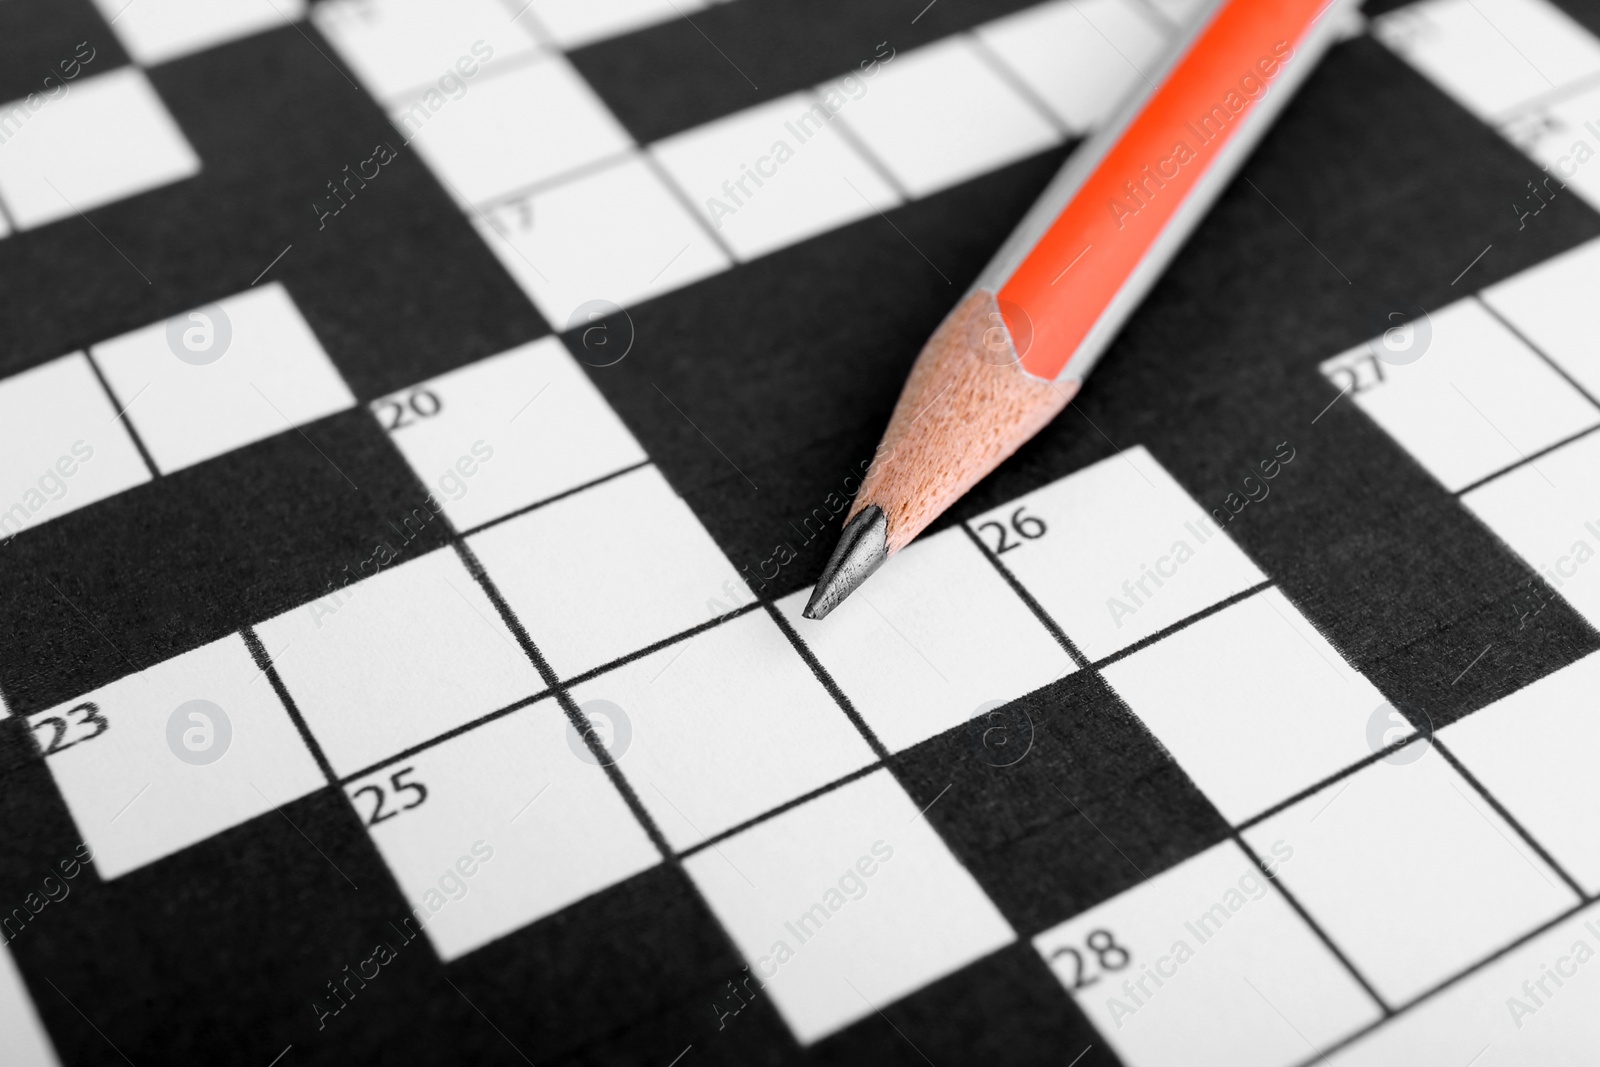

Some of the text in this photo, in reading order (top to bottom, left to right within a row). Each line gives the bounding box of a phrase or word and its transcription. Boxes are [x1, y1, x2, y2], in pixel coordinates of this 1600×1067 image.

[1328, 353, 1388, 395] 27
[374, 387, 441, 431] 20
[978, 507, 1048, 554] 26
[33, 702, 109, 756] 23
[352, 766, 429, 827] 25
[1051, 928, 1131, 991] 28
